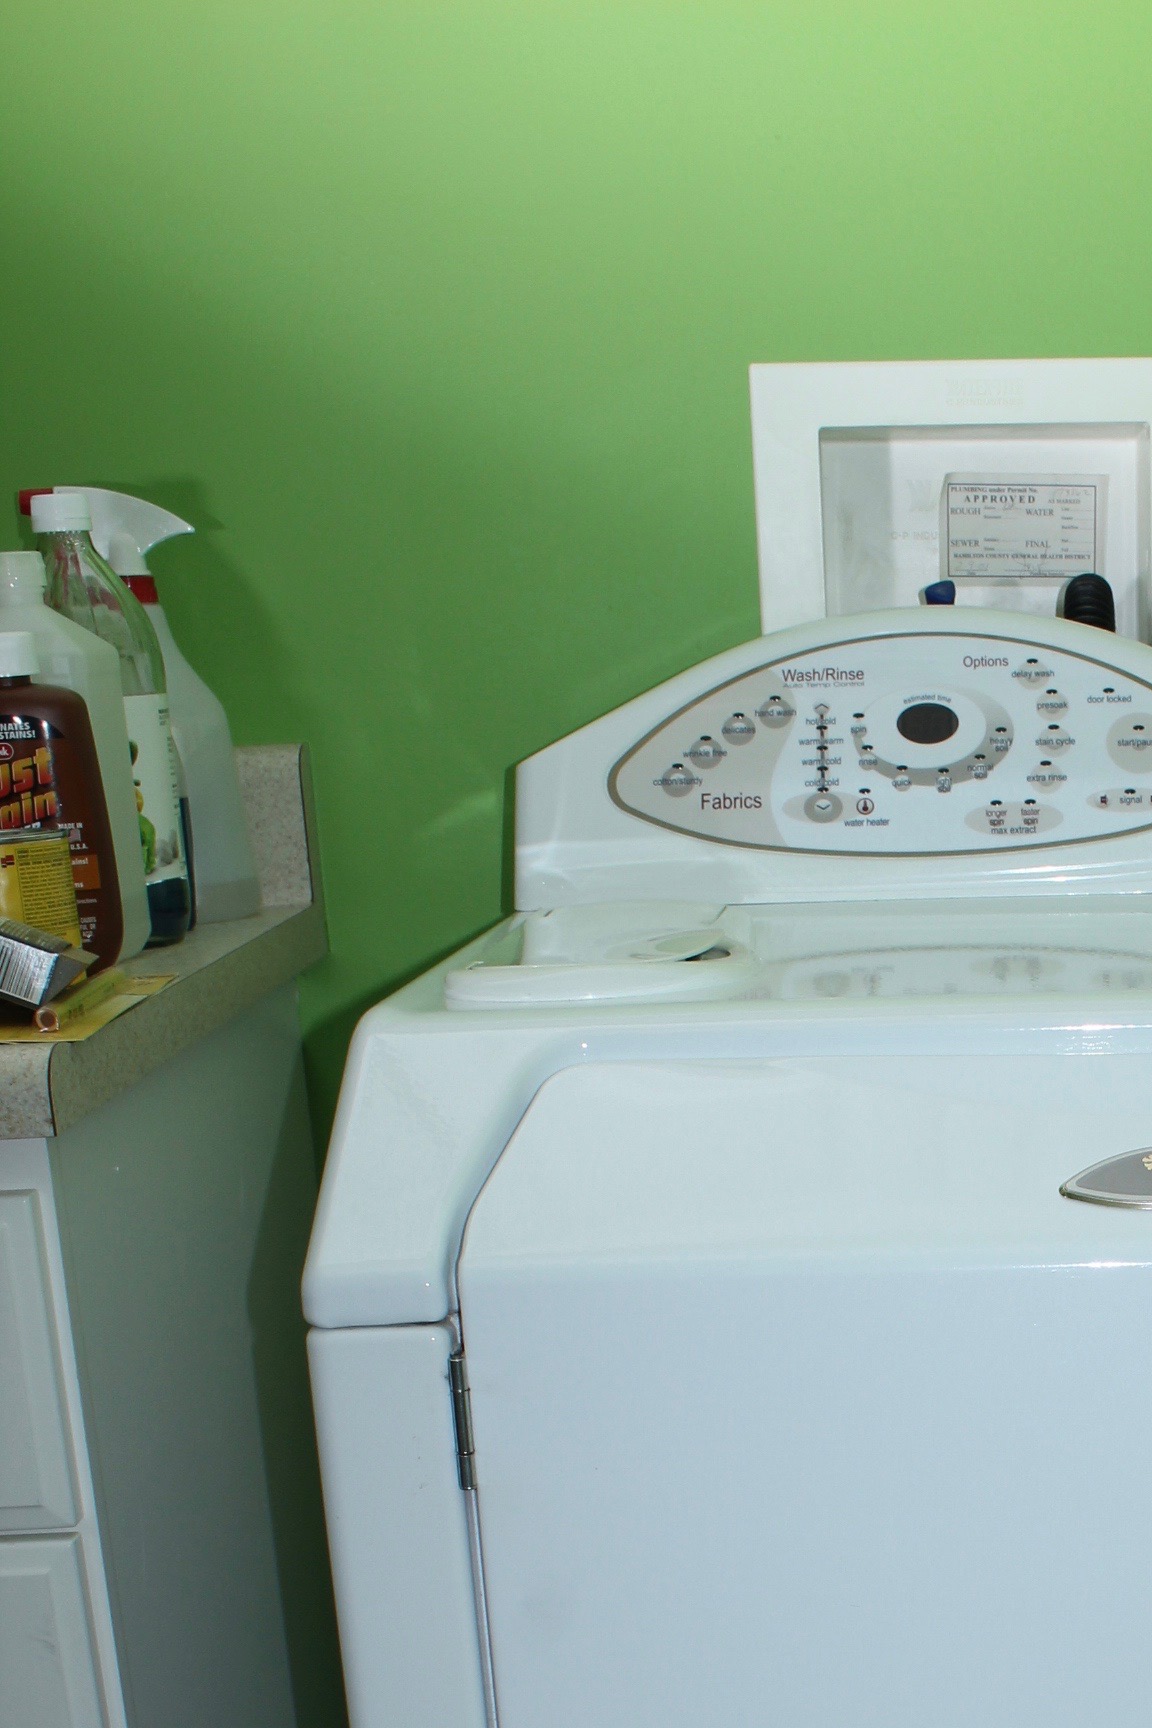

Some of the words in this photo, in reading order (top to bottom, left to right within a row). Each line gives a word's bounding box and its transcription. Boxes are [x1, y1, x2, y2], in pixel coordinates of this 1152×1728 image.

[964, 494, 1036, 504] APPROVED
[950, 507, 981, 515] ROUGH
[1025, 508, 1054, 516] WATER
[1025, 540, 1051, 548] FINAL
[963, 655, 1009, 670] Options
[782, 667, 865, 682] Wash/Rinse
[1011, 669, 1033, 679] delay
[1034, 669, 1055, 677] wash
[903, 694, 936, 704] estimated
[937, 694, 952, 704] time
[1087, 695, 1104, 703] door
[1106, 695, 1132, 703] locked
[1036, 701, 1068, 711] presoak
[0, 721, 30, 731] NATES
[722, 726, 757, 735] delicates
[850, 725, 867, 734] spin
[1035, 738, 1054, 746] stain
[1055, 737, 1076, 747] cycle
[859, 757, 878, 766] rinse
[1026, 774, 1046, 782] extra
[1048, 773, 1068, 782] rinse
[891, 778, 913, 788] quick
[701, 792, 762, 810] Fabrics
[1119, 795, 1143, 805] signal
[985, 809, 1007, 819] longer
[1020, 808, 1040, 816] faster
[844, 819, 865, 827] water
[866, 818, 890, 827] heater
[990, 827, 1008, 835] max
[1010, 826, 1037, 835] extract
